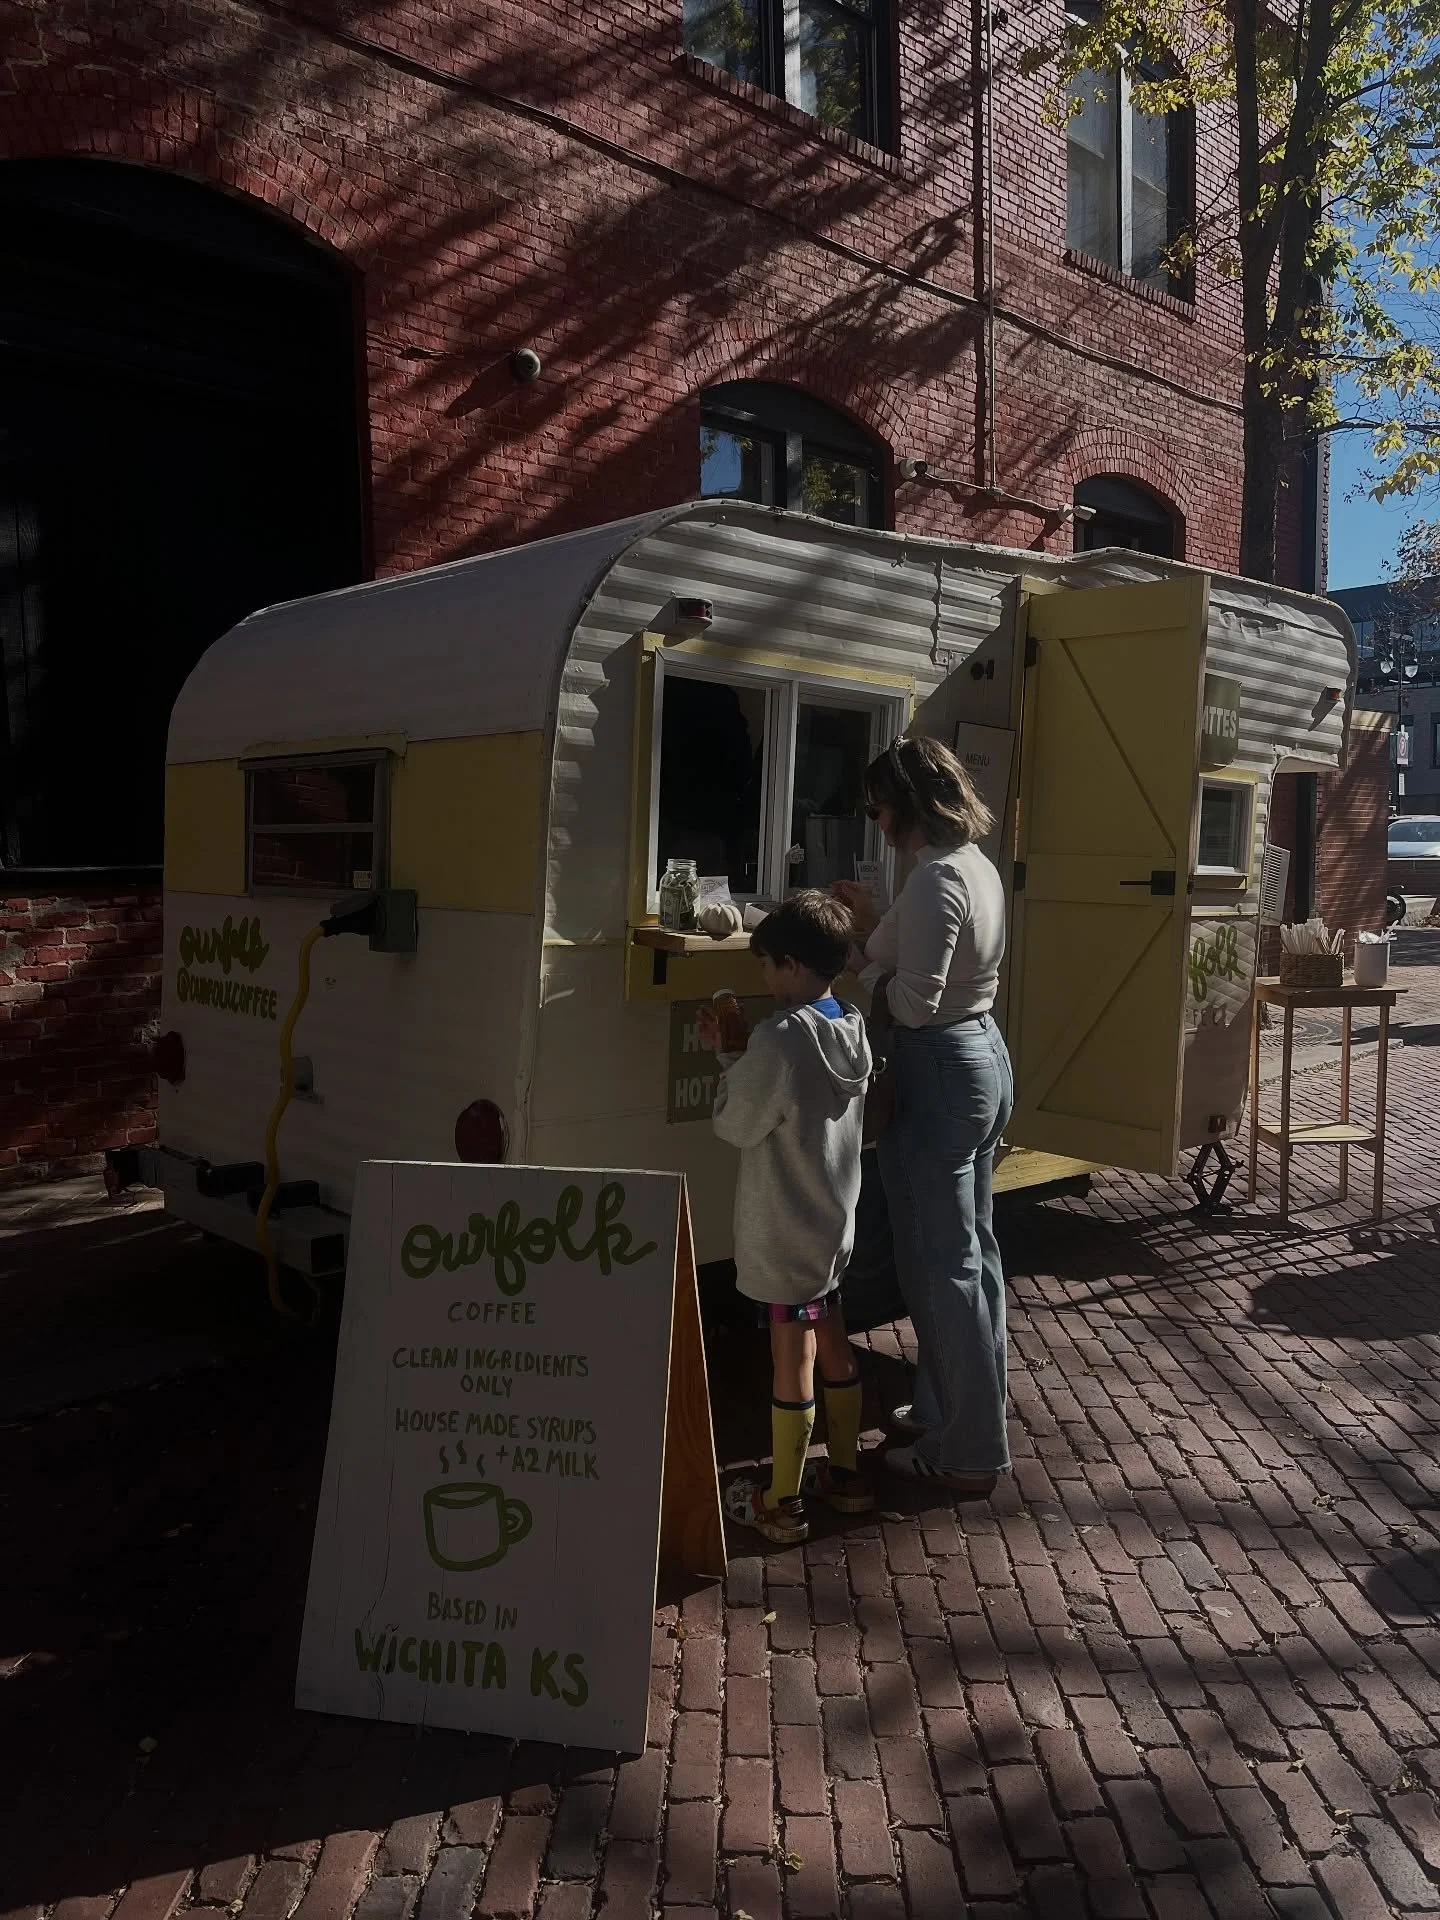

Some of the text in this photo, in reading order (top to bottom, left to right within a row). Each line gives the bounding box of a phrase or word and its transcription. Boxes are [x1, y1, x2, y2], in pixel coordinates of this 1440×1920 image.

[965, 751, 990, 768] MENU
[401, 1181, 658, 1297] ourfolk
[448, 1302, 536, 1325] COFFEE
[392, 1347, 589, 1378] CLEAN INGREDIENTS
[460, 1374, 513, 1398] ONLY
[395, 1408, 597, 1445] HOUSE MADE SYRUPS
[545, 1449, 600, 1480] MILK
[426, 1591, 518, 1631] BASED IN
[354, 1628, 589, 1707] WICHITA KS
